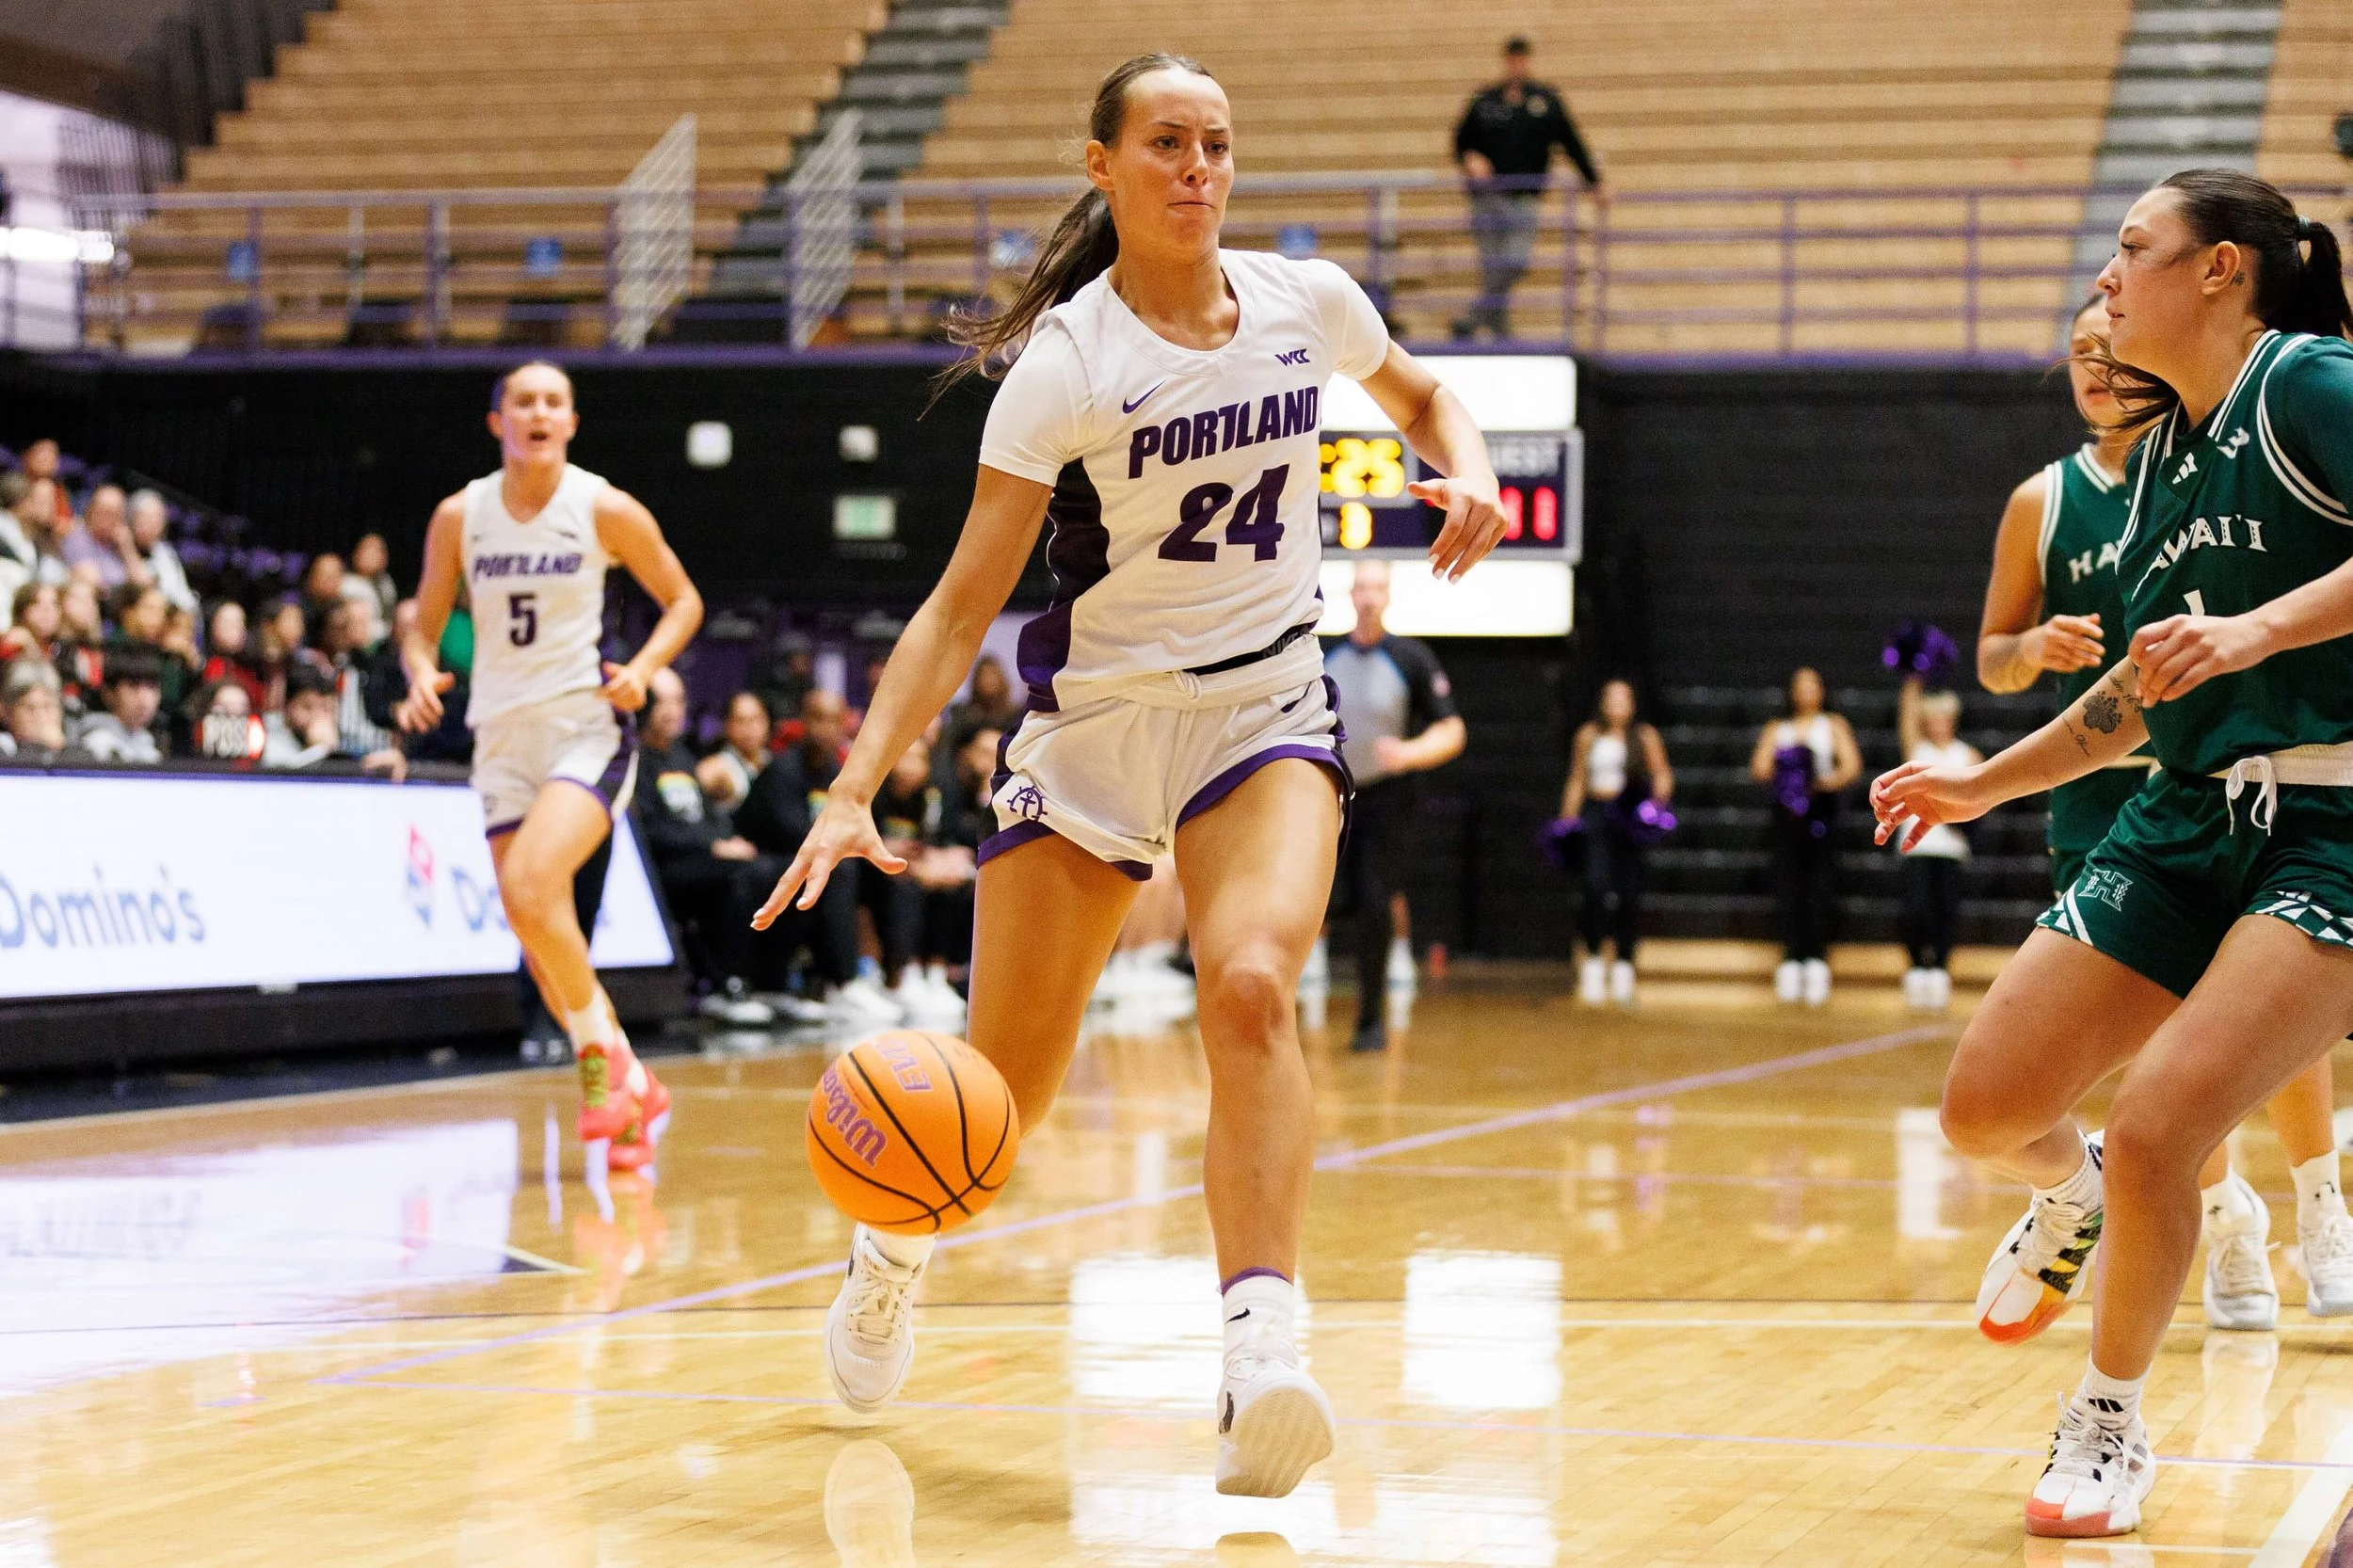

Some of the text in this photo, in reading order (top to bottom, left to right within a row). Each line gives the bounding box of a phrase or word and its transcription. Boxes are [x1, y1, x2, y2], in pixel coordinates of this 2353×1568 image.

[1274, 348, 1311, 366] WCC
[1128, 386, 1319, 479] PORTLAND
[1158, 464, 1289, 562] 24
[473, 552, 583, 583] PORTLAND
[2131, 514, 2267, 601] AWAI'I
[509, 592, 537, 647] 5
